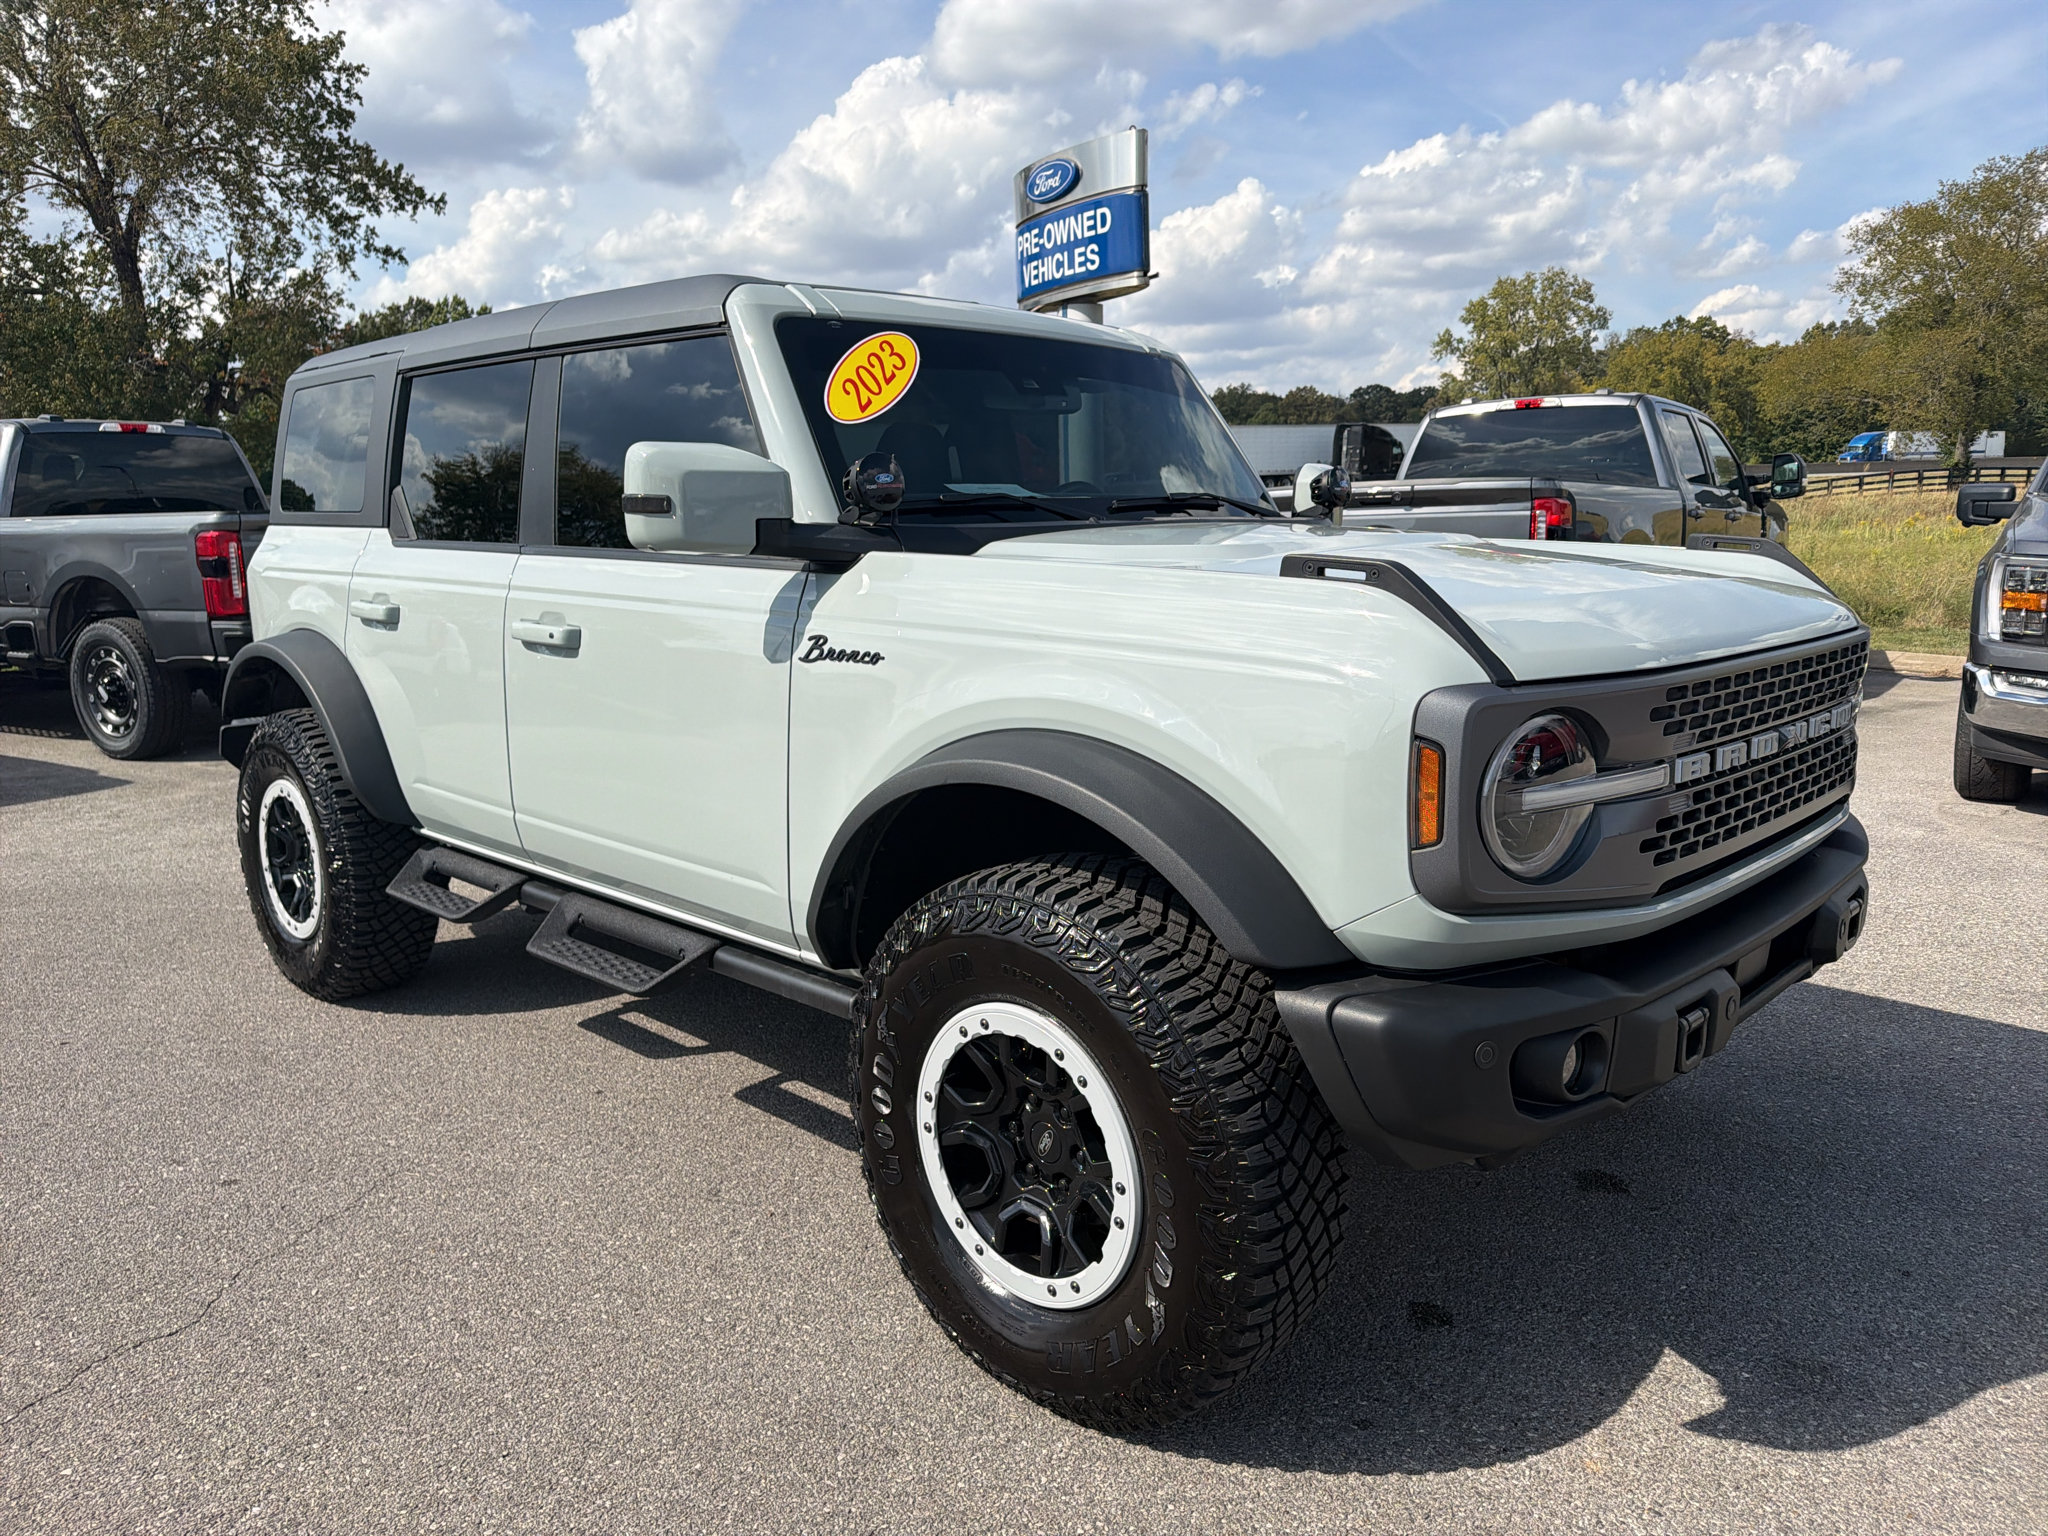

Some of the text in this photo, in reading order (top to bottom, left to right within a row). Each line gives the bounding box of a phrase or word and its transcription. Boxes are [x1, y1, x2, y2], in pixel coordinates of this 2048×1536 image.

[1034, 168, 1062, 195] Ford
[1017, 207, 1112, 260] PRE-OWNED
[1023, 243, 1100, 288] VEHICLES
[842, 339, 906, 414] 2023
[798, 634, 885, 666] Bronco
